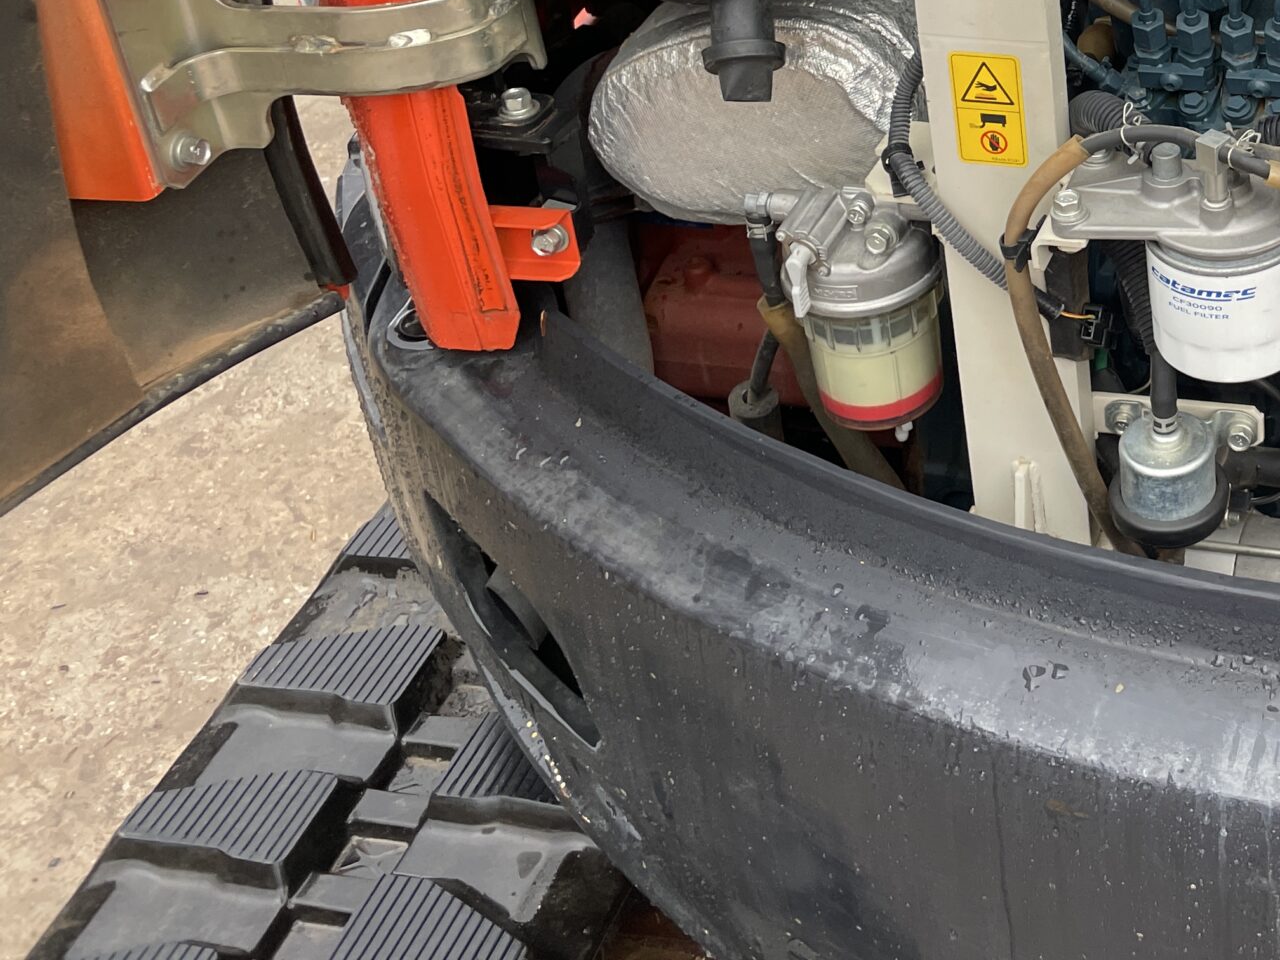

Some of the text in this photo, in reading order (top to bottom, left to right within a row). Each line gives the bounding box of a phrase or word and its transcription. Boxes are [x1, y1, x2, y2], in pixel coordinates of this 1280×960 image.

[1168, 301, 1230, 320] FUEL FILTER
[1172, 296, 1223, 312] CF30090
